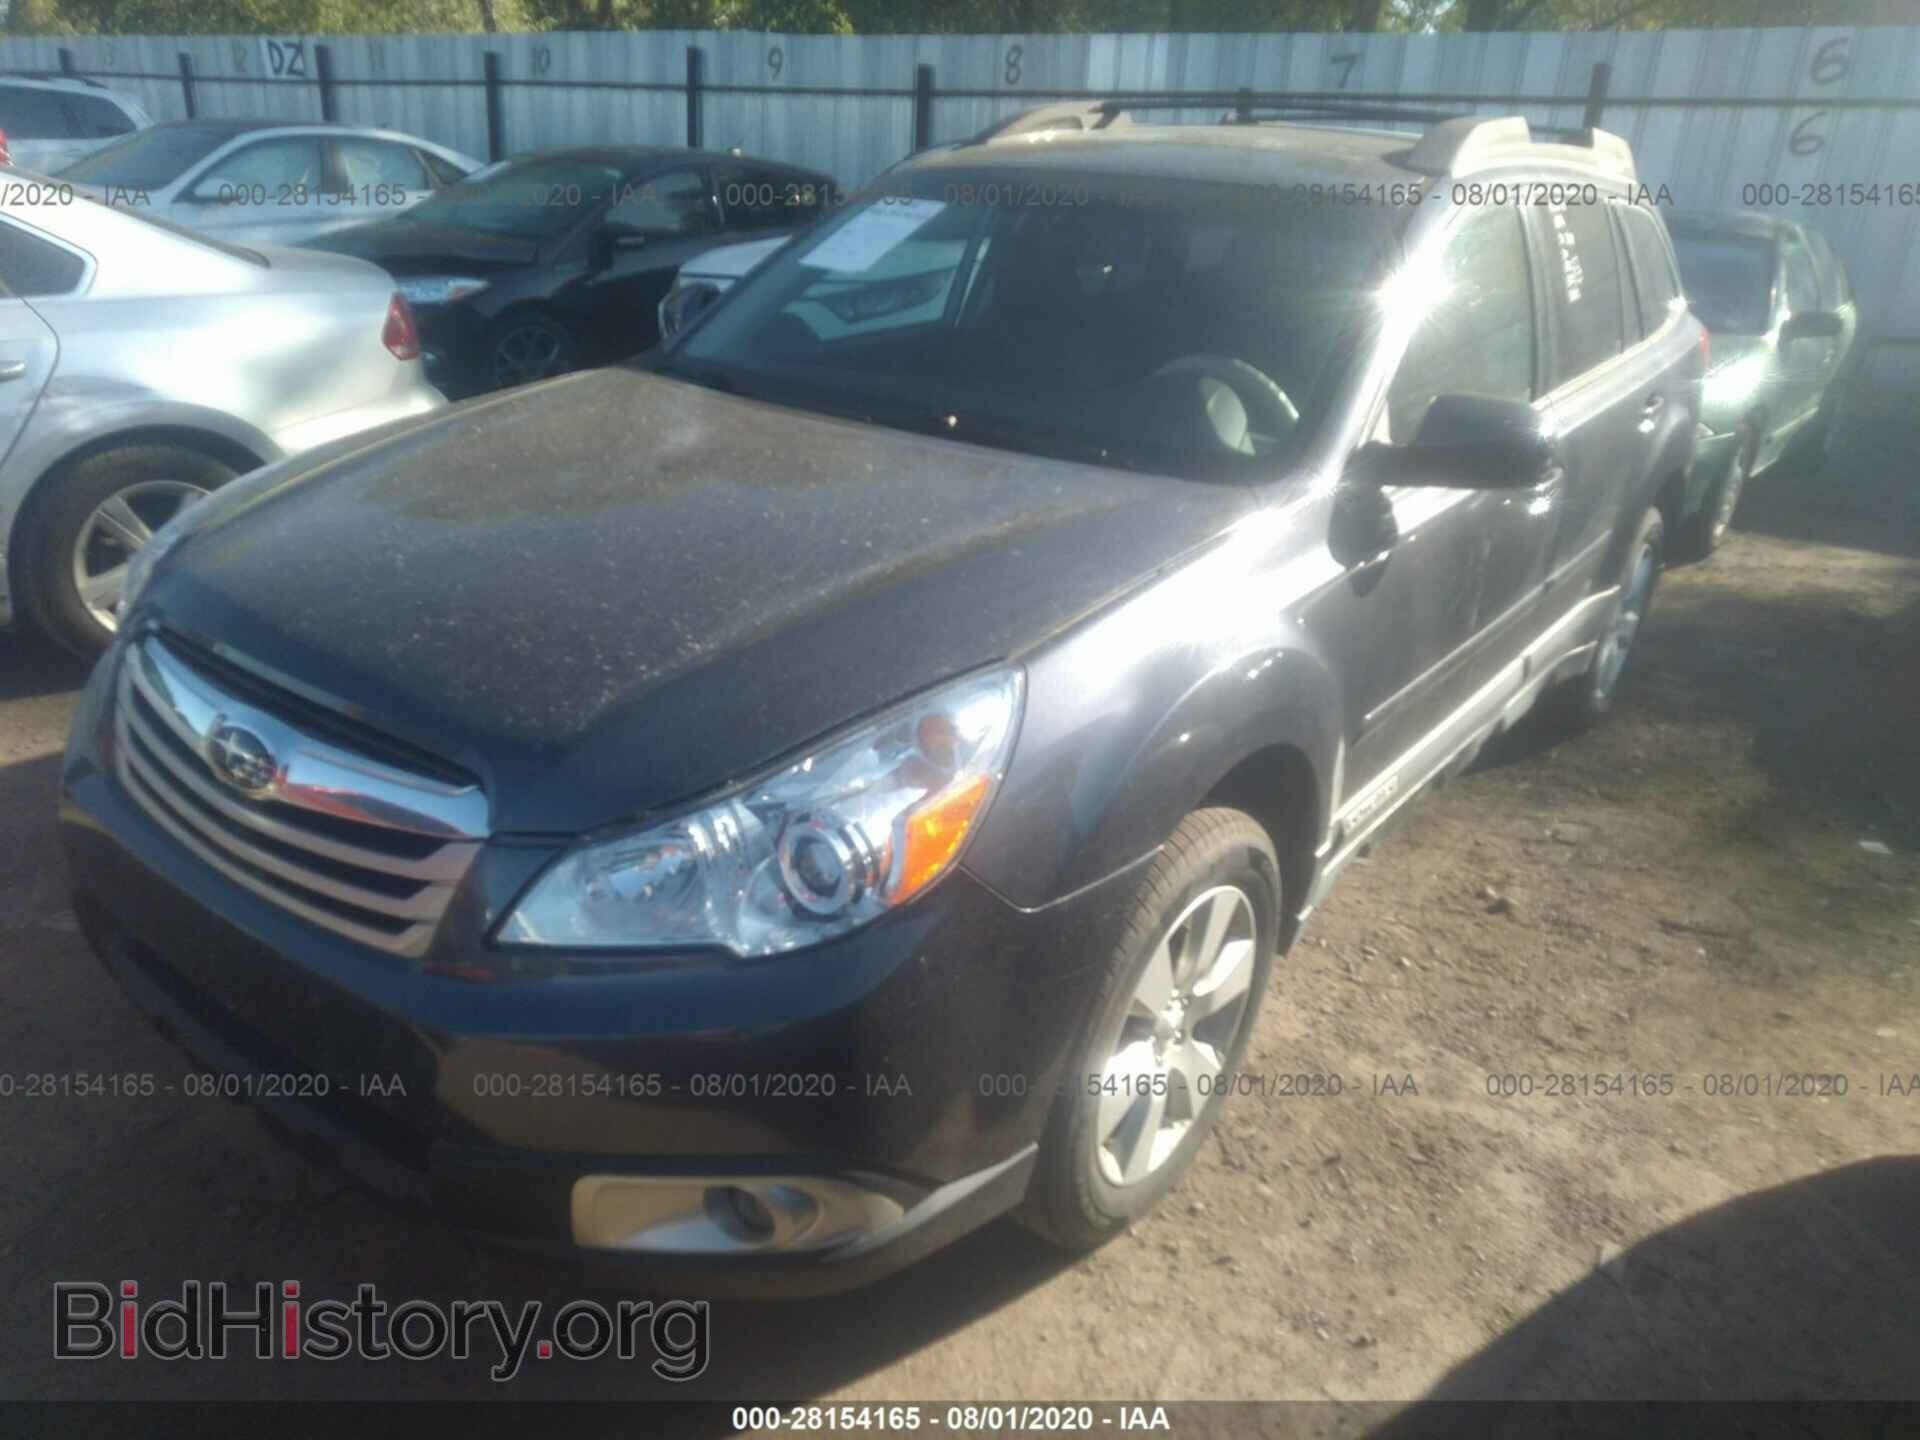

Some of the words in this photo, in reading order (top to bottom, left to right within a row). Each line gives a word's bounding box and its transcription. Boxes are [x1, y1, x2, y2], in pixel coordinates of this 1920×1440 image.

[768, 47, 783, 79] 9
[1004, 45, 1023, 85] 8
[1331, 53, 1357, 88] 7
[1810, 37, 1850, 85] 6
[1790, 112, 1828, 157] 6
